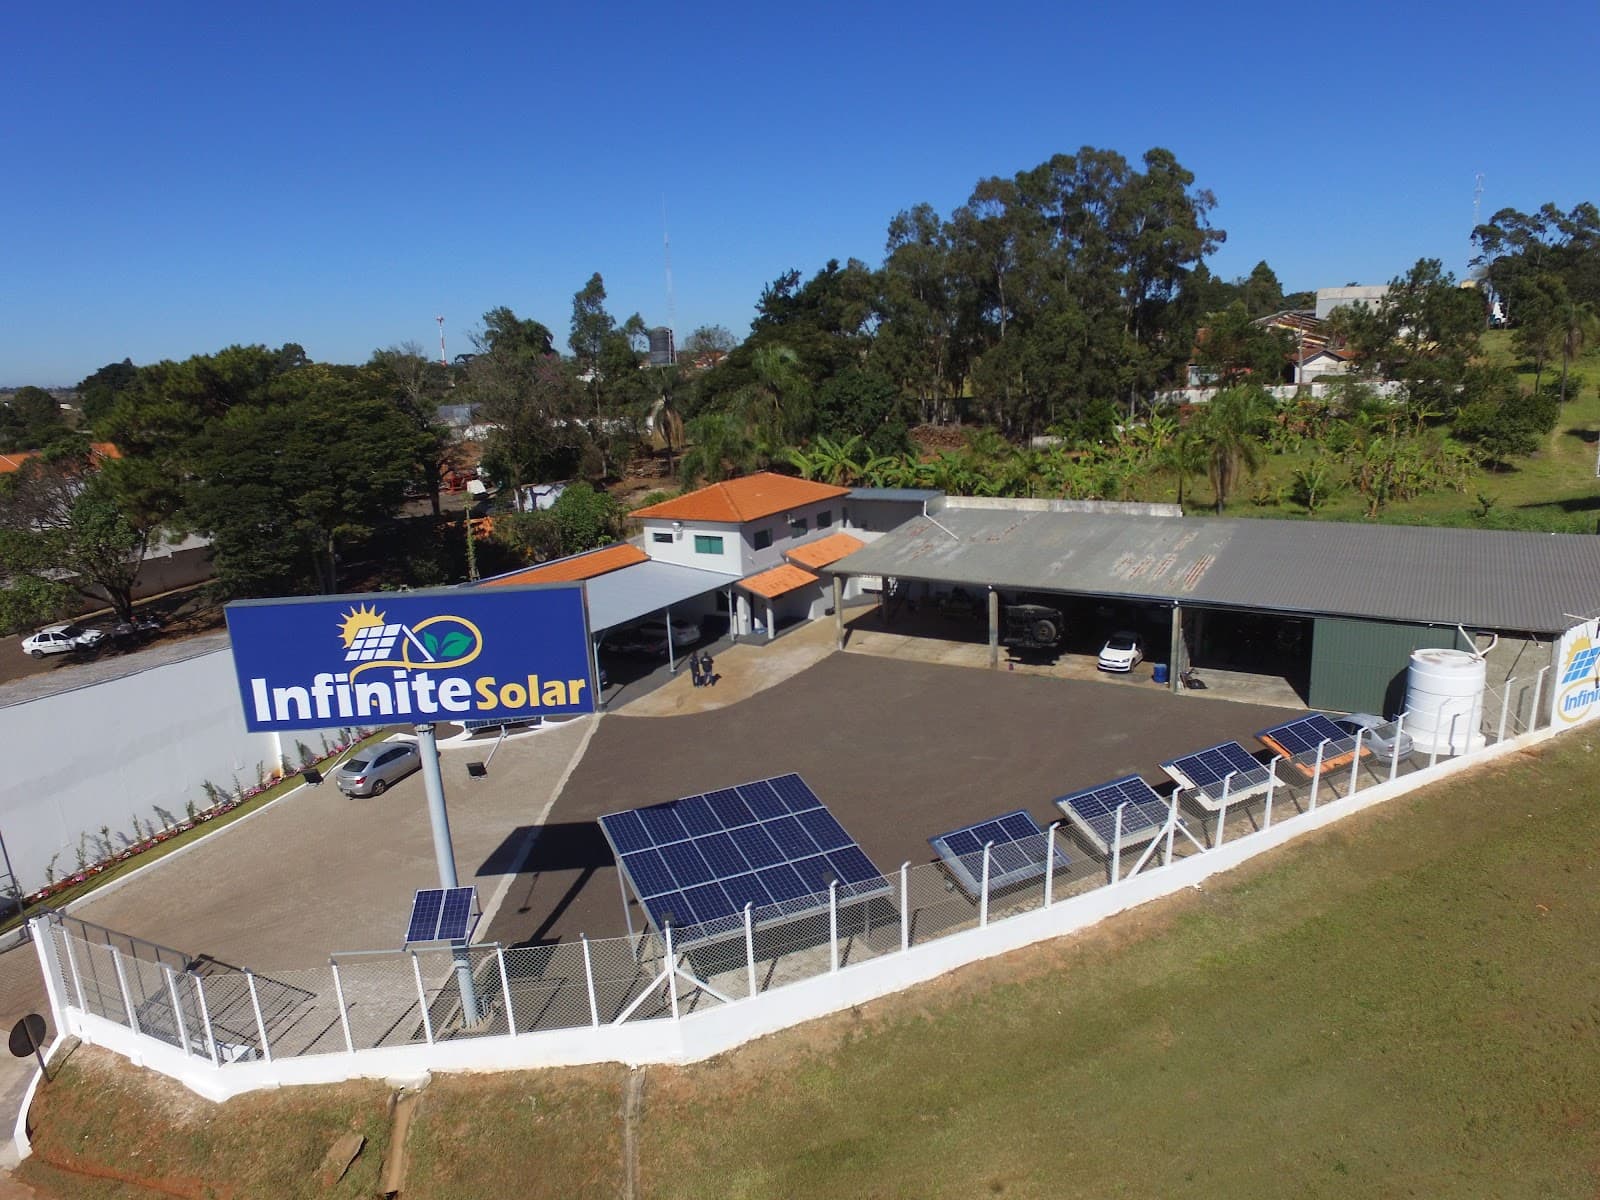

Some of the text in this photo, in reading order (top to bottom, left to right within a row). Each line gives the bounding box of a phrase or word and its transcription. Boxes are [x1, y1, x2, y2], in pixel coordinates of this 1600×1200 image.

[251, 669, 585, 722] Infinite Solar
[1564, 689, 1600, 712] Infini
